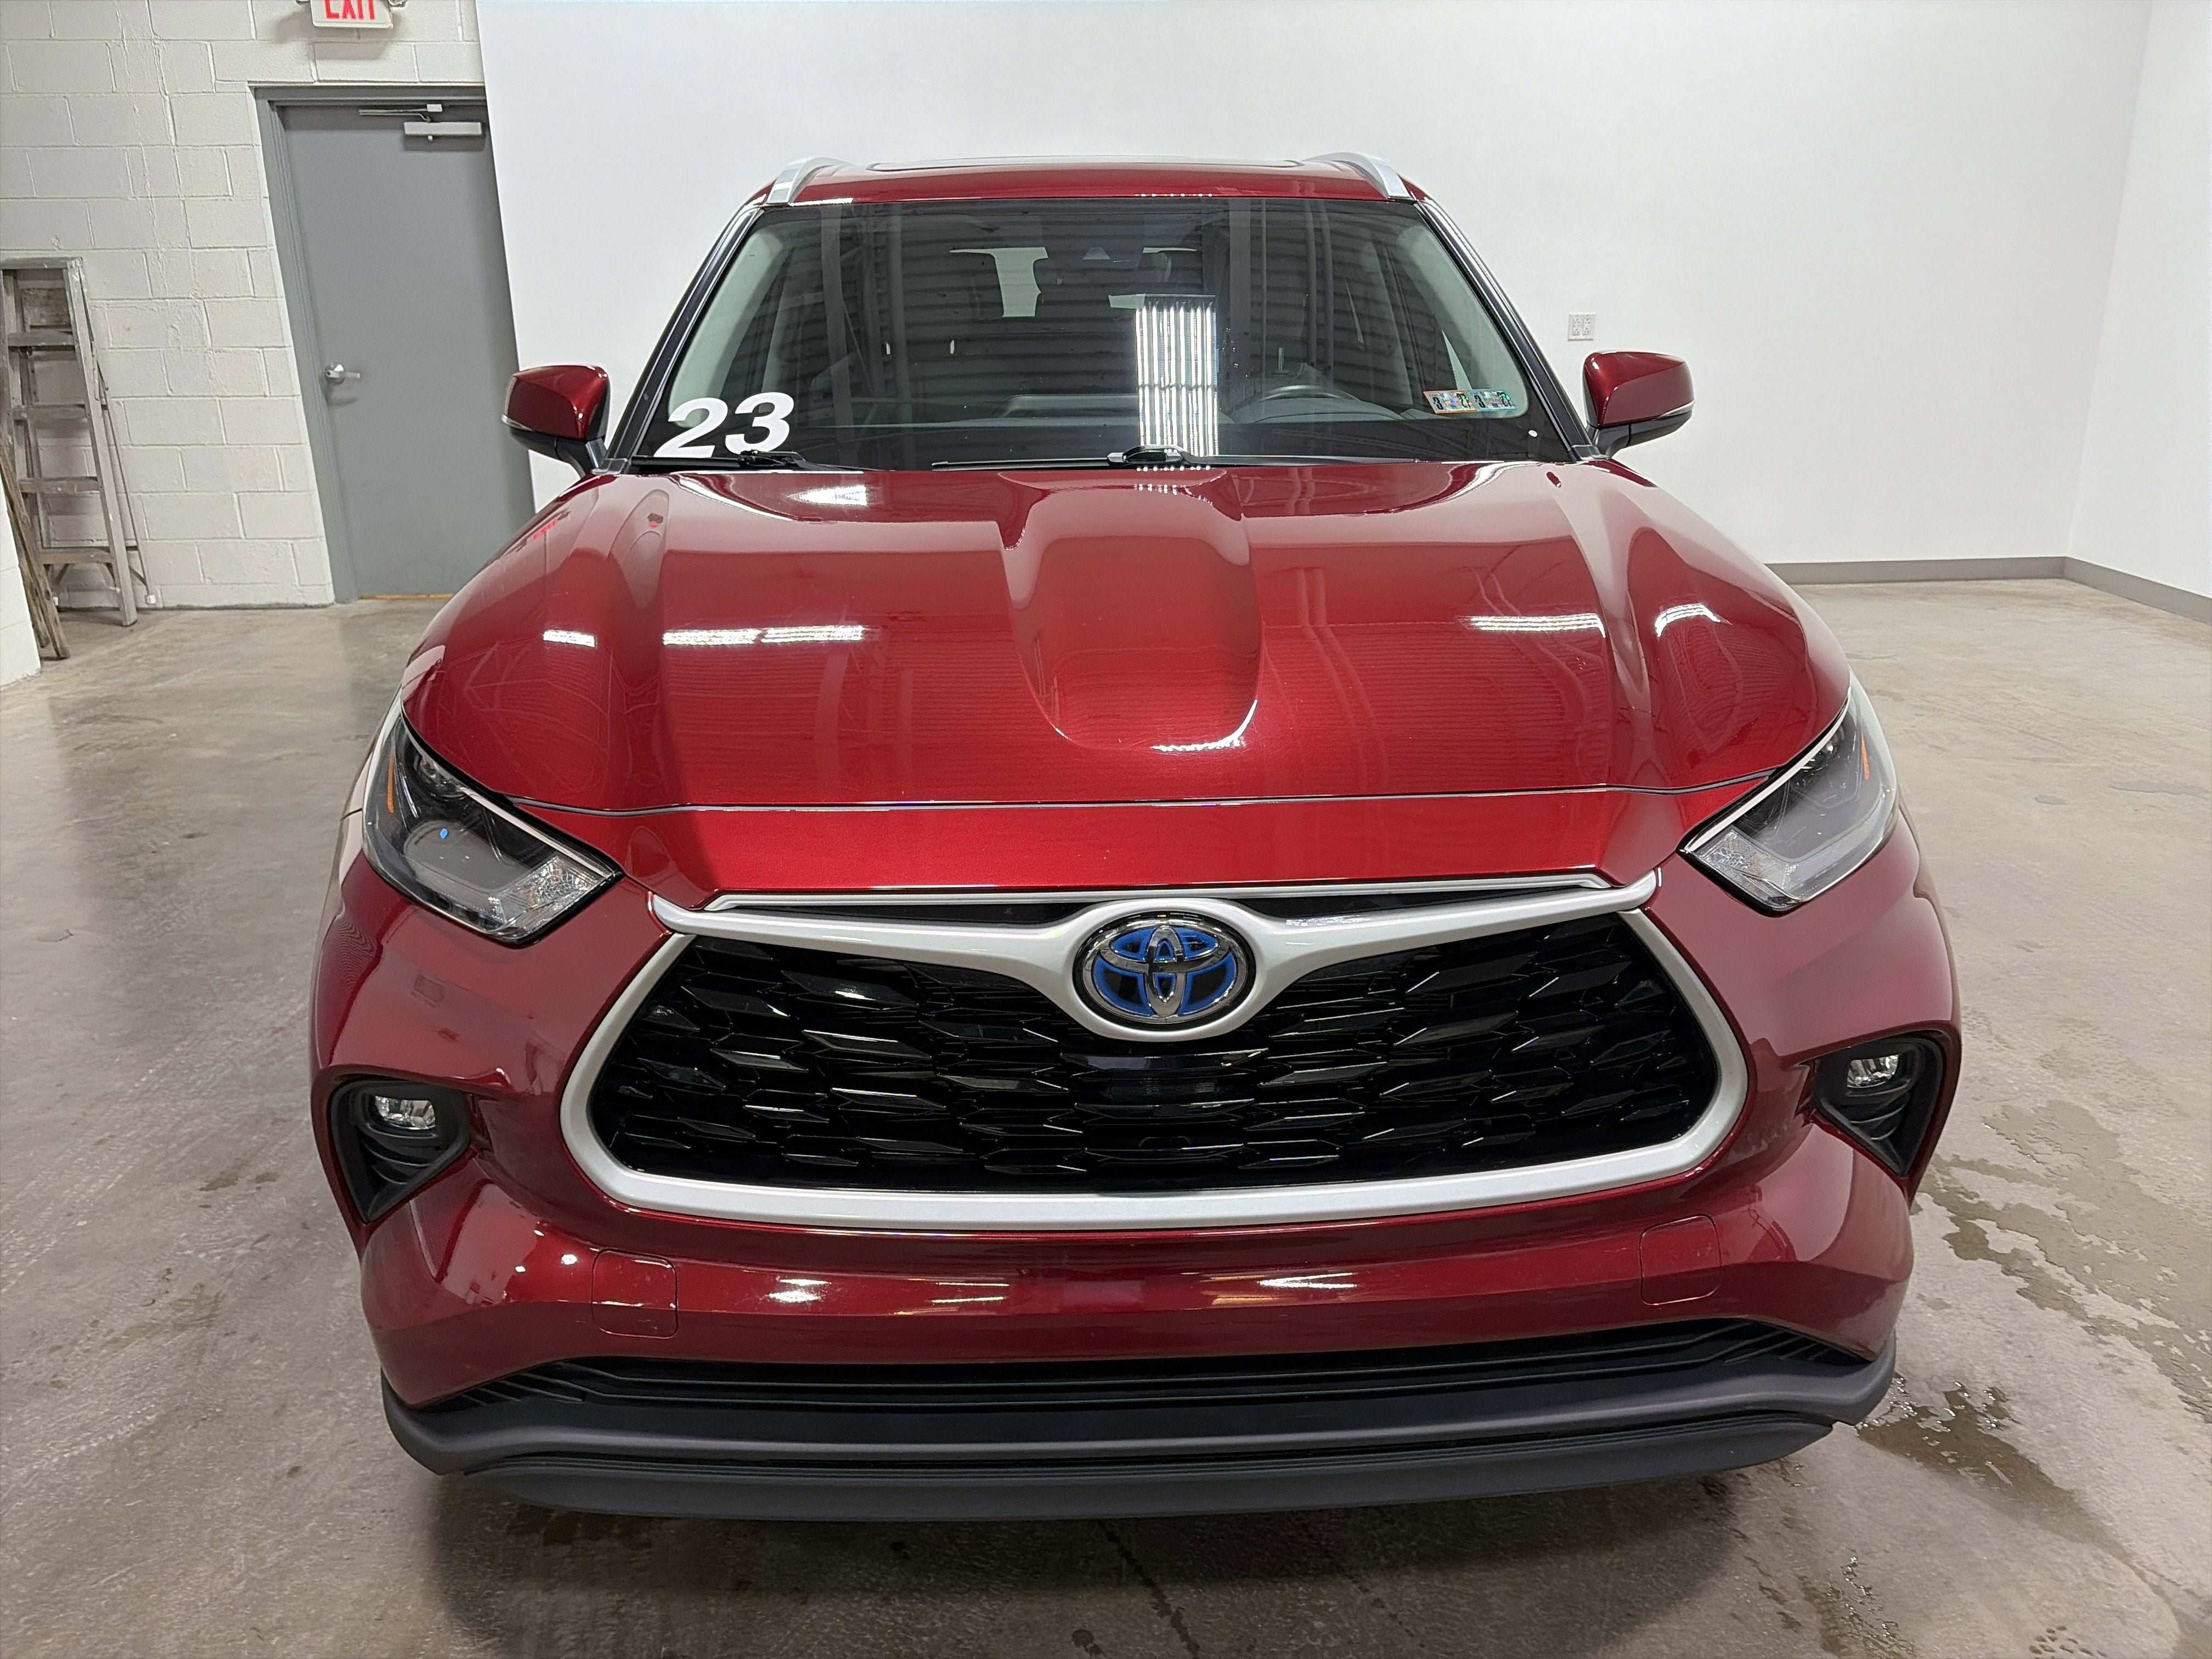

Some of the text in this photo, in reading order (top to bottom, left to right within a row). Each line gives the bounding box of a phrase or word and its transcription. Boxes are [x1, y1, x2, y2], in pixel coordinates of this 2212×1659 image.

[1432, 397, 1444, 410] 3
[1474, 395, 1486, 408] 3
[653, 392, 794, 458] 23
